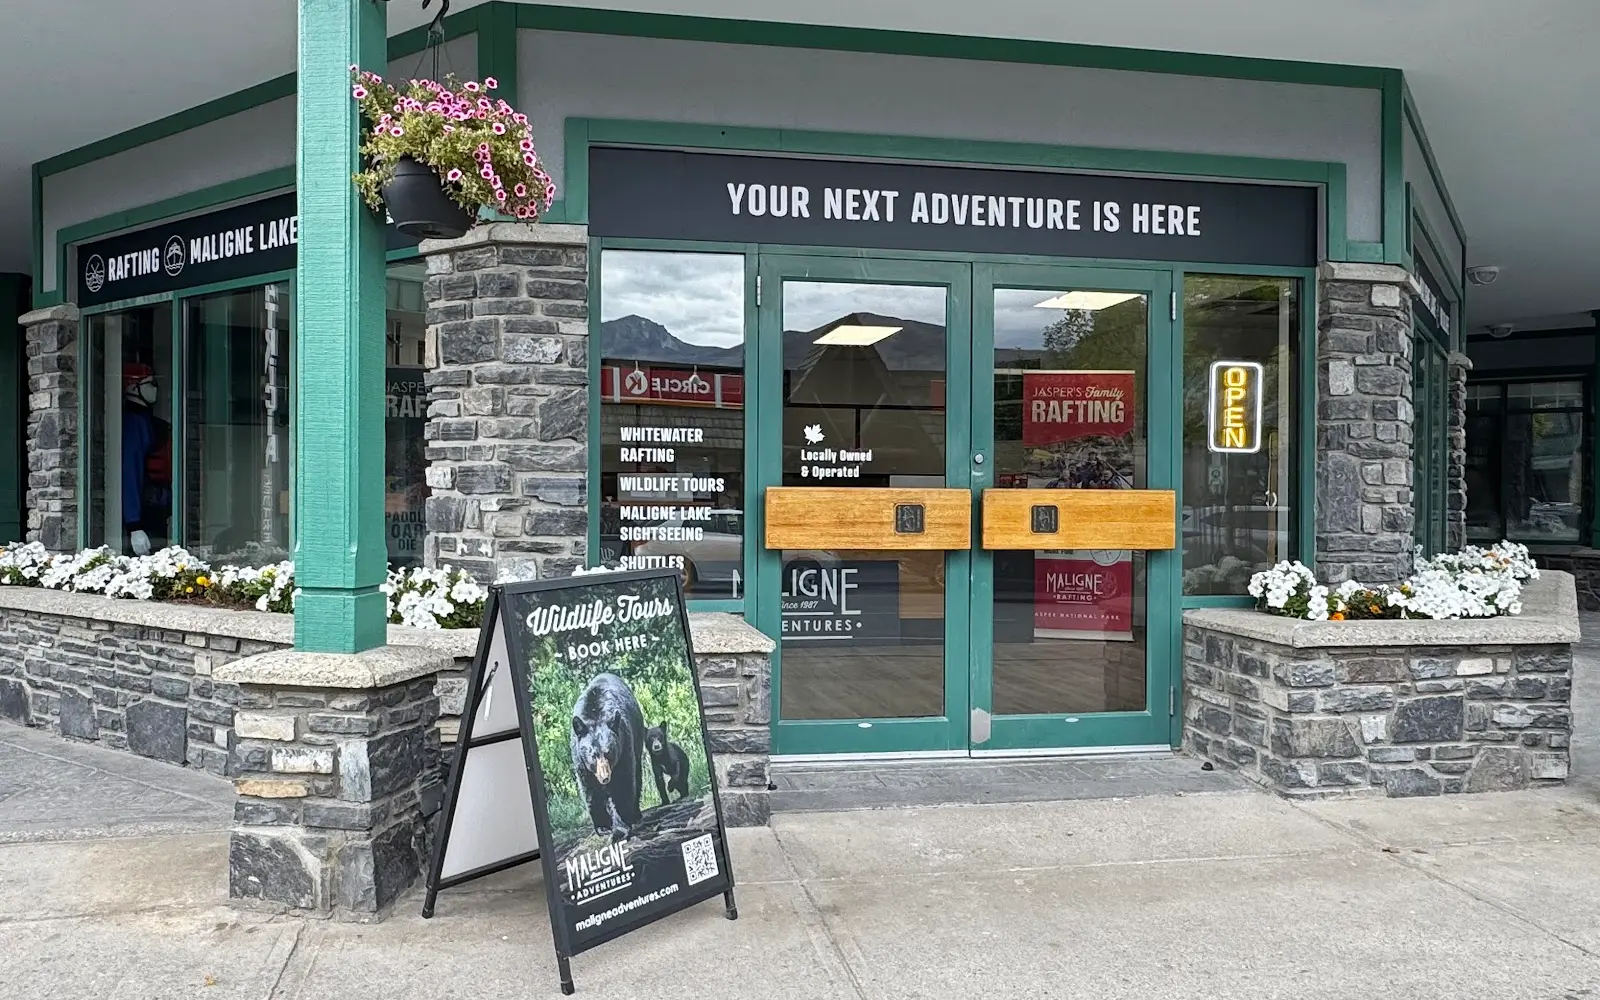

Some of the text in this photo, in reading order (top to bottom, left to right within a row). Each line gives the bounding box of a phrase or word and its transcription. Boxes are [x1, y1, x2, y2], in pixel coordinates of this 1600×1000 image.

[727, 182, 1201, 236] YOUR NEXT ADVENTURE IS HERE
[108, 214, 298, 282] RAFTING MALIGNE LAKE
[1033, 386, 1124, 400] JASPER'S Family
[1031, 400, 1125, 423] RAFTING
[1224, 367, 1248, 448] OPEN
[620, 427, 703, 442] WHITEWATER
[620, 447, 675, 462] RAFTING
[801, 448, 872, 464] Locally Owned
[801, 466, 859, 480] & Operated
[620, 477, 725, 492] WILDLIFE TOURS
[620, 506, 712, 521] MALIGNE LAKE
[620, 526, 704, 541] SIGHTSEEING
[620, 555, 685, 570] SHUTTLES
[1046, 573, 1103, 594] MALIGNE
[800, 601, 818, 609] 1987
[526, 595, 673, 636] Wildlife Tours
[568, 634, 647, 660] BOOK HERE
[565, 839, 634, 892] MALIGNE
[576, 872, 631, 900] ADVENTURES
[575, 883, 679, 931] maligneadventures.com
